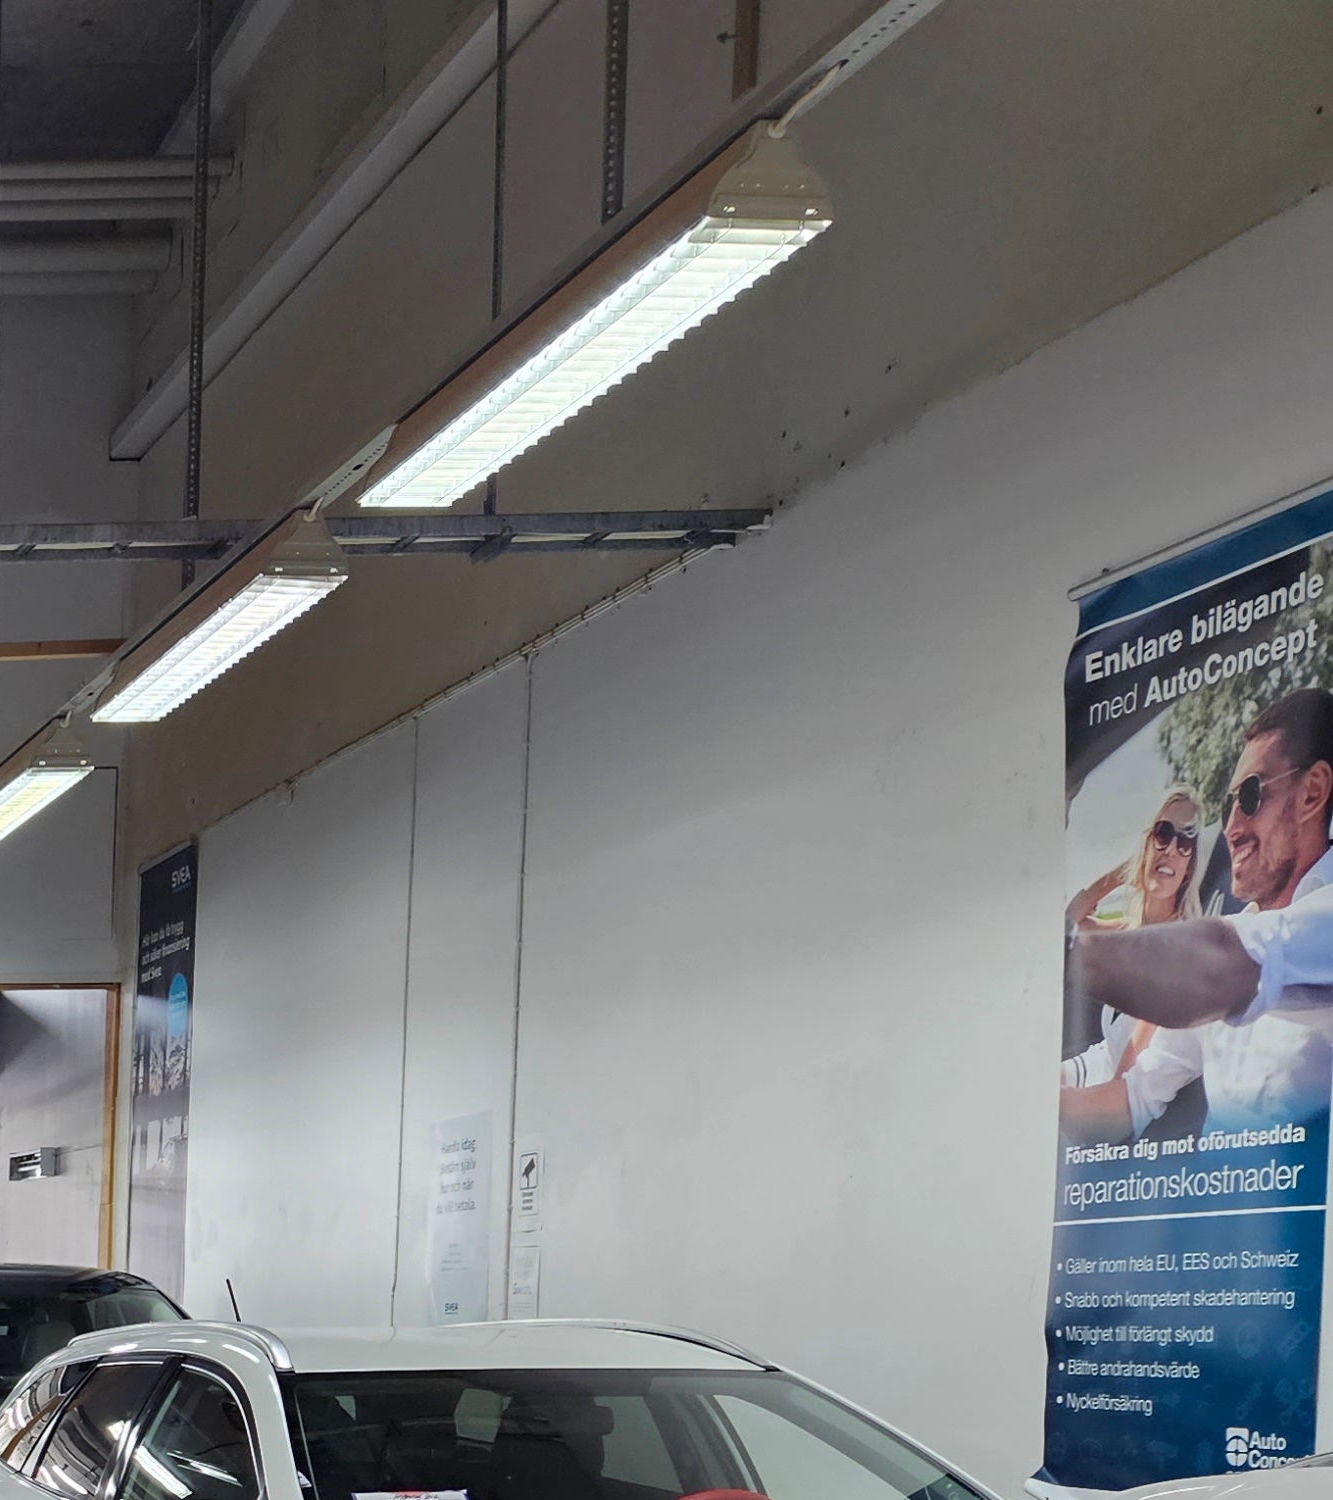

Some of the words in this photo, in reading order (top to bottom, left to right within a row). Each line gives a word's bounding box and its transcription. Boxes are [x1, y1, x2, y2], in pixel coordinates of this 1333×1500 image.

[1085, 629, 1183, 683] Enklare
[1190, 572, 1325, 645] bilägande
[1089, 683, 1138, 726] med
[1143, 619, 1319, 708] AutoConcept
[171, 865, 191, 887] SVEA
[1065, 1142, 1130, 1165] Försäkra
[1134, 1139, 1158, 1161] dig
[1162, 1134, 1194, 1156] mot
[1198, 1122, 1306, 1151] oförutsedda
[1064, 1159, 1305, 1212] reparationskostnader
[1066, 1258, 1098, 1275] Gäller
[1099, 1256, 1128, 1273] inom
[1129, 1255, 1154, 1272] hela
[1156, 1254, 1179, 1273] EU,
[1183, 1252, 1210, 1270] EES
[1213, 1252, 1236, 1270] och
[1241, 1249, 1299, 1270] Schweiz
[1064, 1291, 1100, 1308] Snabb
[1101, 1292, 1123, 1308] och
[1125, 1291, 1191, 1311] kompetent
[1193, 1288, 1296, 1309] skadehantering
[1066, 1325, 1114, 1345] Möjlighet
[1115, 1326, 1127, 1342] till
[1128, 1325, 1172, 1346] förlängt
[1174, 1326, 1214, 1346] skydd
[1067, 1359, 1099, 1376] Bättre
[1100, 1361, 1201, 1379] andrahandsvärde
[1066, 1393, 1153, 1416] Nyckelförsäkring
[1249, 1431, 1287, 1451] Auto
[1248, 1450, 1310, 1469] Conce
